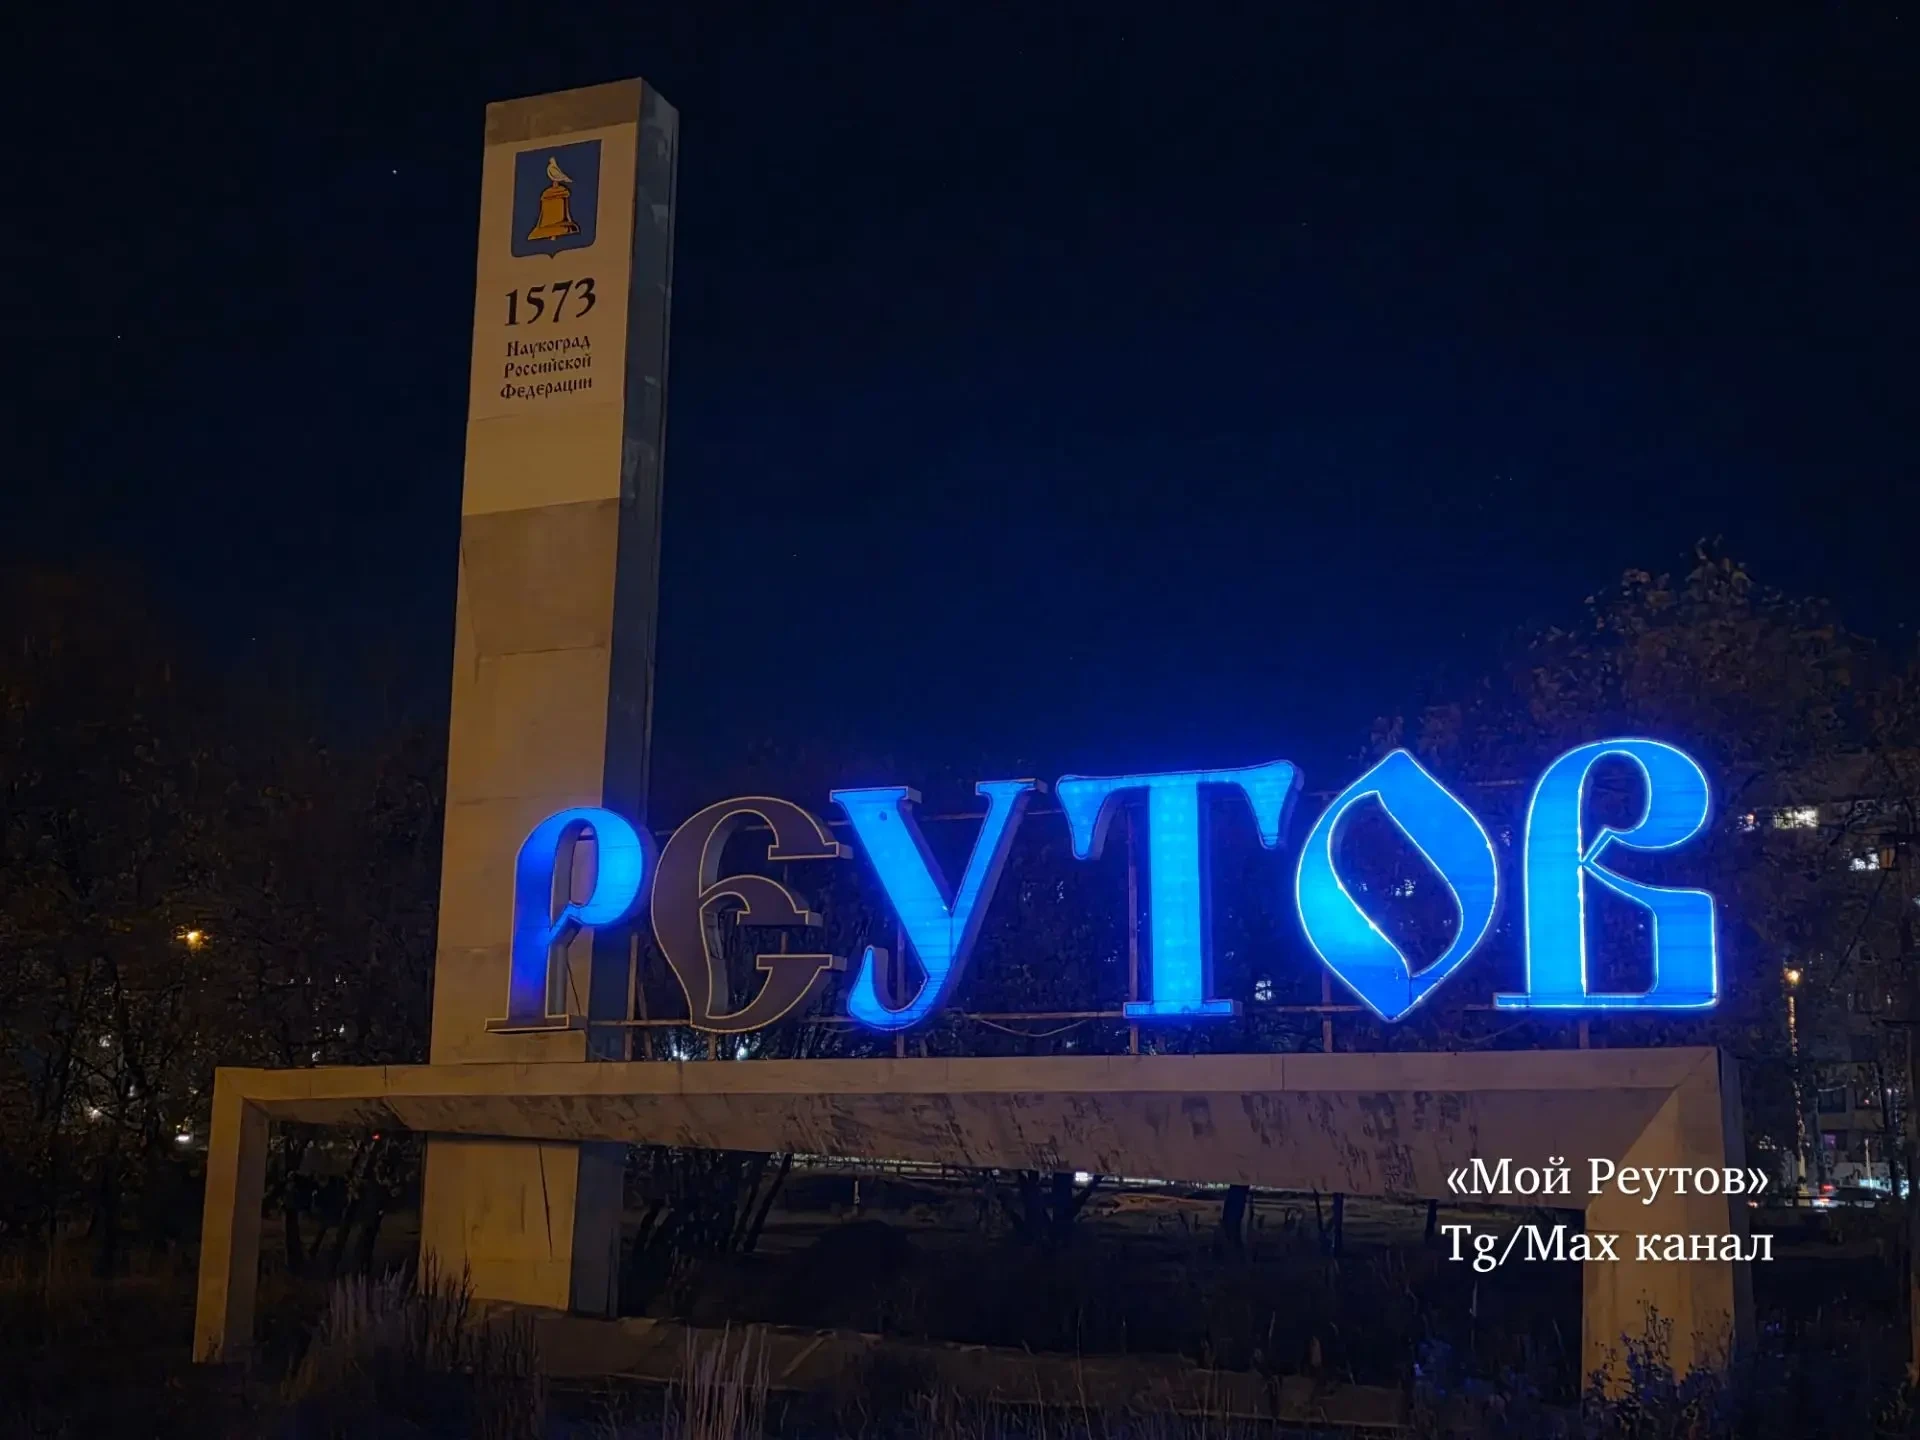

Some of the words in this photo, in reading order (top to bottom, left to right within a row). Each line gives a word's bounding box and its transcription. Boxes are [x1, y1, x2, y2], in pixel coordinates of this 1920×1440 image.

[504, 277, 597, 326] 1573
[506, 335, 592, 358] Наукоград
[503, 353, 592, 378] Российской
[500, 377, 593, 400] Федерации
[486, 737, 1721, 1034] РЕУТОВ
